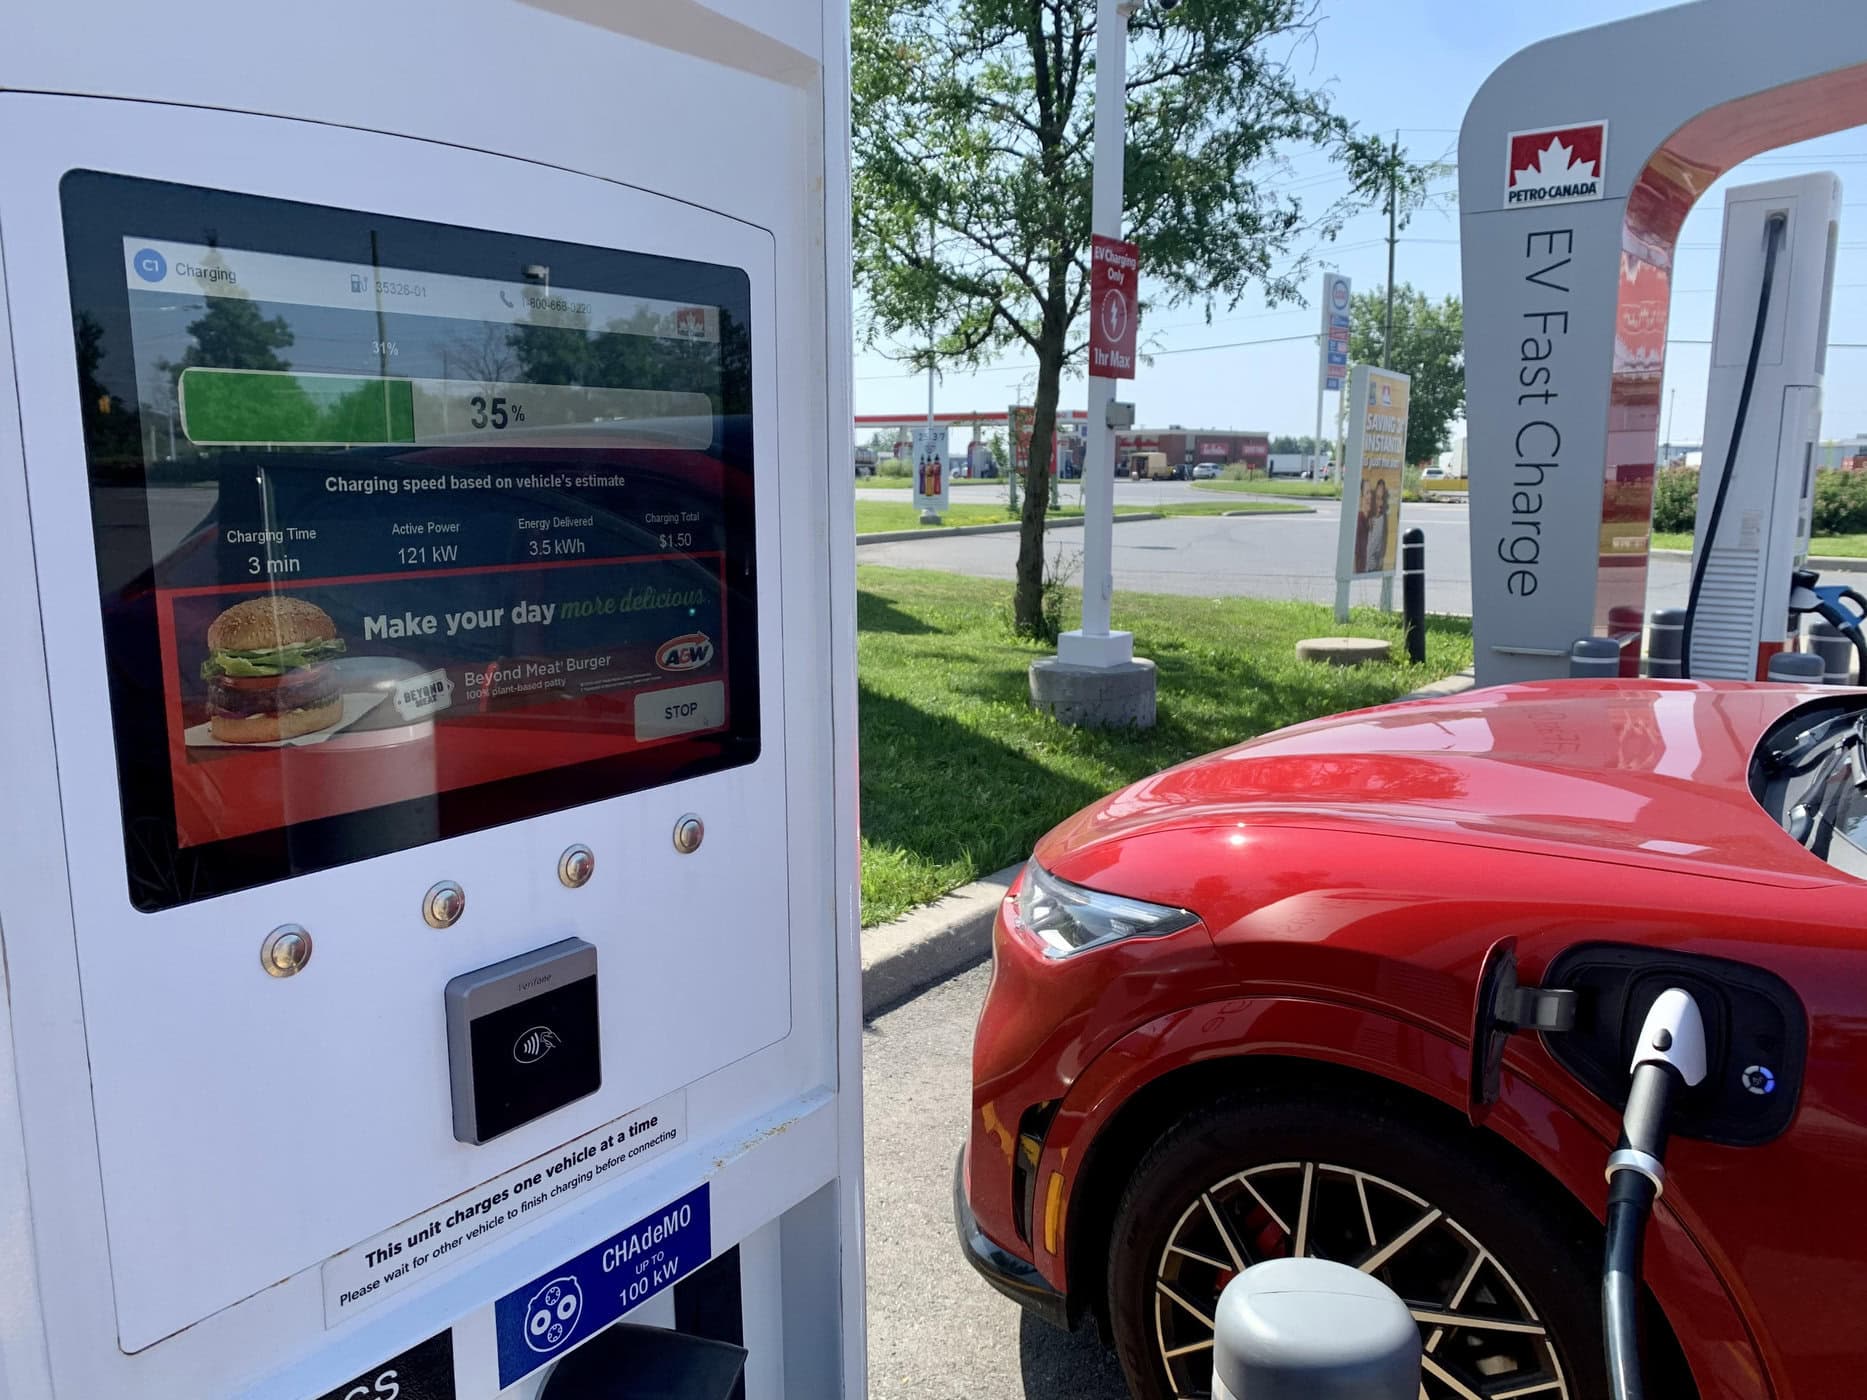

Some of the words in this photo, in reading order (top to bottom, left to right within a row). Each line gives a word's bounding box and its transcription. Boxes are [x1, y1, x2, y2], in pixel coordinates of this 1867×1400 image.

[1094, 246, 1104, 260] EV
[1104, 249, 1136, 270] Charging
[1526, 229, 1573, 292] EV
[175, 262, 236, 284] Charging
[1107, 267, 1125, 285] Only
[372, 341, 399, 356] 31%
[1110, 350, 1130, 368] Max
[1518, 311, 1568, 405] Fast
[470, 397, 525, 430] 35%
[325, 476, 398, 494] Charging
[403, 475, 446, 491] speed
[450, 475, 491, 489] based
[495, 477, 512, 489] on
[516, 474, 572, 489] vehicle's
[575, 473, 625, 487] estimate
[645, 512, 680, 525] Charging
[681, 511, 700, 522] Total
[1498, 421, 1561, 597] Charge
[392, 522, 424, 536] Active
[427, 522, 460, 535] Power
[518, 518, 550, 532] Energy
[553, 516, 594, 529] Delivered
[227, 529, 284, 544] Charging
[286, 527, 317, 541] Time
[659, 533, 692, 548] $1.50
[398, 546, 426, 565] 121
[433, 545, 458, 564] kW
[529, 540, 551, 556] 3.5
[554, 538, 585, 554] kWh
[248, 556, 261, 575] 3
[267, 554, 300, 573] min
[363, 612, 438, 641] Make
[445, 608, 505, 636] your
[511, 601, 556, 626] day
[560, 599, 617, 620] more
[464, 665, 522, 687] Beyond
[566, 655, 612, 671] Burger
[403, 680, 445, 704] BEYOND
[465, 688, 491, 700] 100%
[491, 680, 544, 696] plant-based
[544, 677, 567, 691] patty
[665, 702, 698, 719] STOP
[365, 1243, 402, 1268] This
[407, 1222, 441, 1248] unit
[446, 1189, 509, 1228] charges
[513, 1173, 542, 1194] one
[546, 1145, 596, 1178] vehicle
[600, 1137, 614, 1152] at
[617, 1132, 625, 1143] a
[629, 1115, 658, 1137] time
[340, 1280, 380, 1306] Please
[384, 1263, 409, 1283] wait
[412, 1252, 430, 1269] for
[432, 1236, 463, 1258] other
[466, 1215, 504, 1241] vehicle
[507, 1209, 518, 1220] to
[521, 1193, 548, 1213] finish
[551, 1168, 593, 1198] charging
[596, 1154, 626, 1175] before
[628, 1128, 677, 1158] connecting
[602, 1204, 691, 1273] CHAdeMO
[635, 1263, 649, 1274] UP
[652, 1251, 664, 1265] TO
[619, 1279, 648, 1307] 100
[653, 1257, 679, 1286] kW
